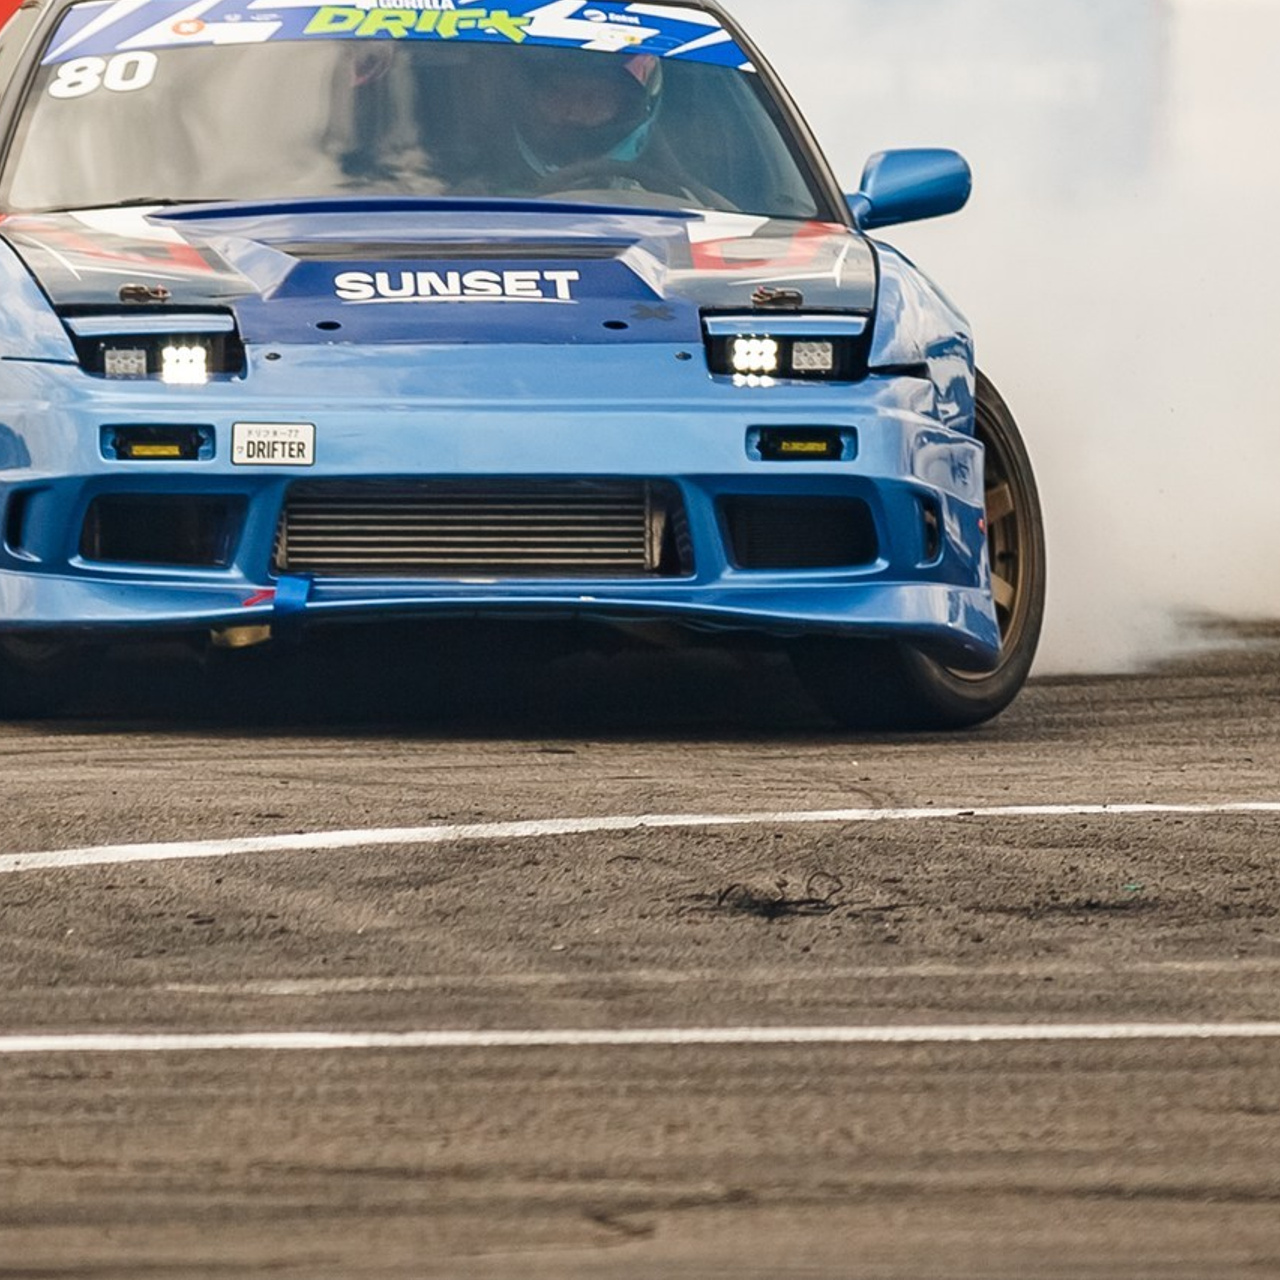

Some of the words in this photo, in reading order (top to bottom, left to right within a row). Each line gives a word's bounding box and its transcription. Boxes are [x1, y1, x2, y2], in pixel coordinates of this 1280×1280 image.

[302, 5, 532, 44] DRIFT
[48, 50, 159, 99] 80
[334, 270, 581, 300] SUNSET
[246, 440, 307, 459] DRIFTER
